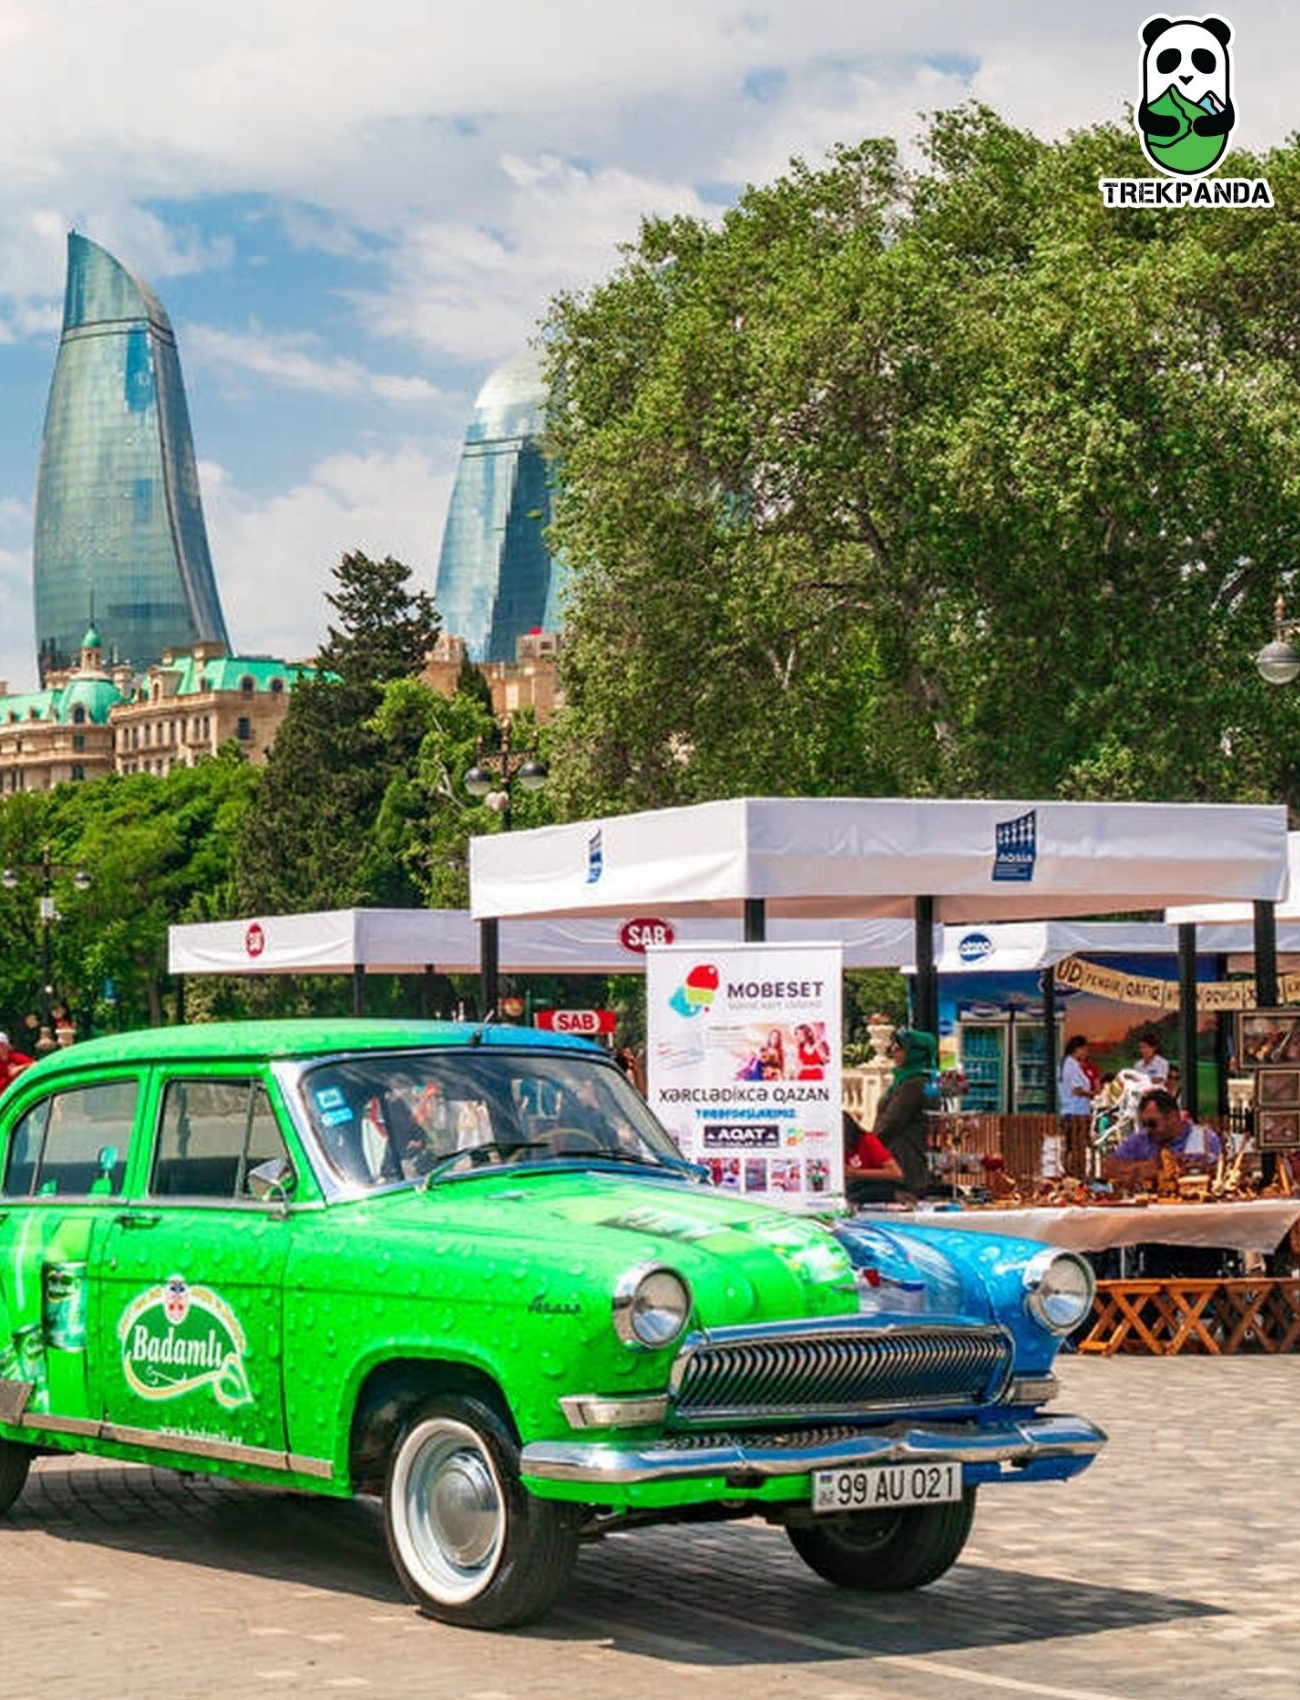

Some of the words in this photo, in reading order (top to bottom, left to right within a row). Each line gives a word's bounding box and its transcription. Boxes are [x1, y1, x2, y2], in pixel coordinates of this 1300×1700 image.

[629, 925, 666, 946] SAB
[727, 981, 824, 998] MOBESET
[558, 1012, 595, 1031] SAB
[772, 1088, 830, 1104] QAZAN
[718, 1128, 766, 1143] AQAT
[133, 1324, 222, 1368] Badamlı
[837, 1474, 867, 1505] 99
[875, 1469, 905, 1503] AU
[911, 1467, 953, 1499] 021
